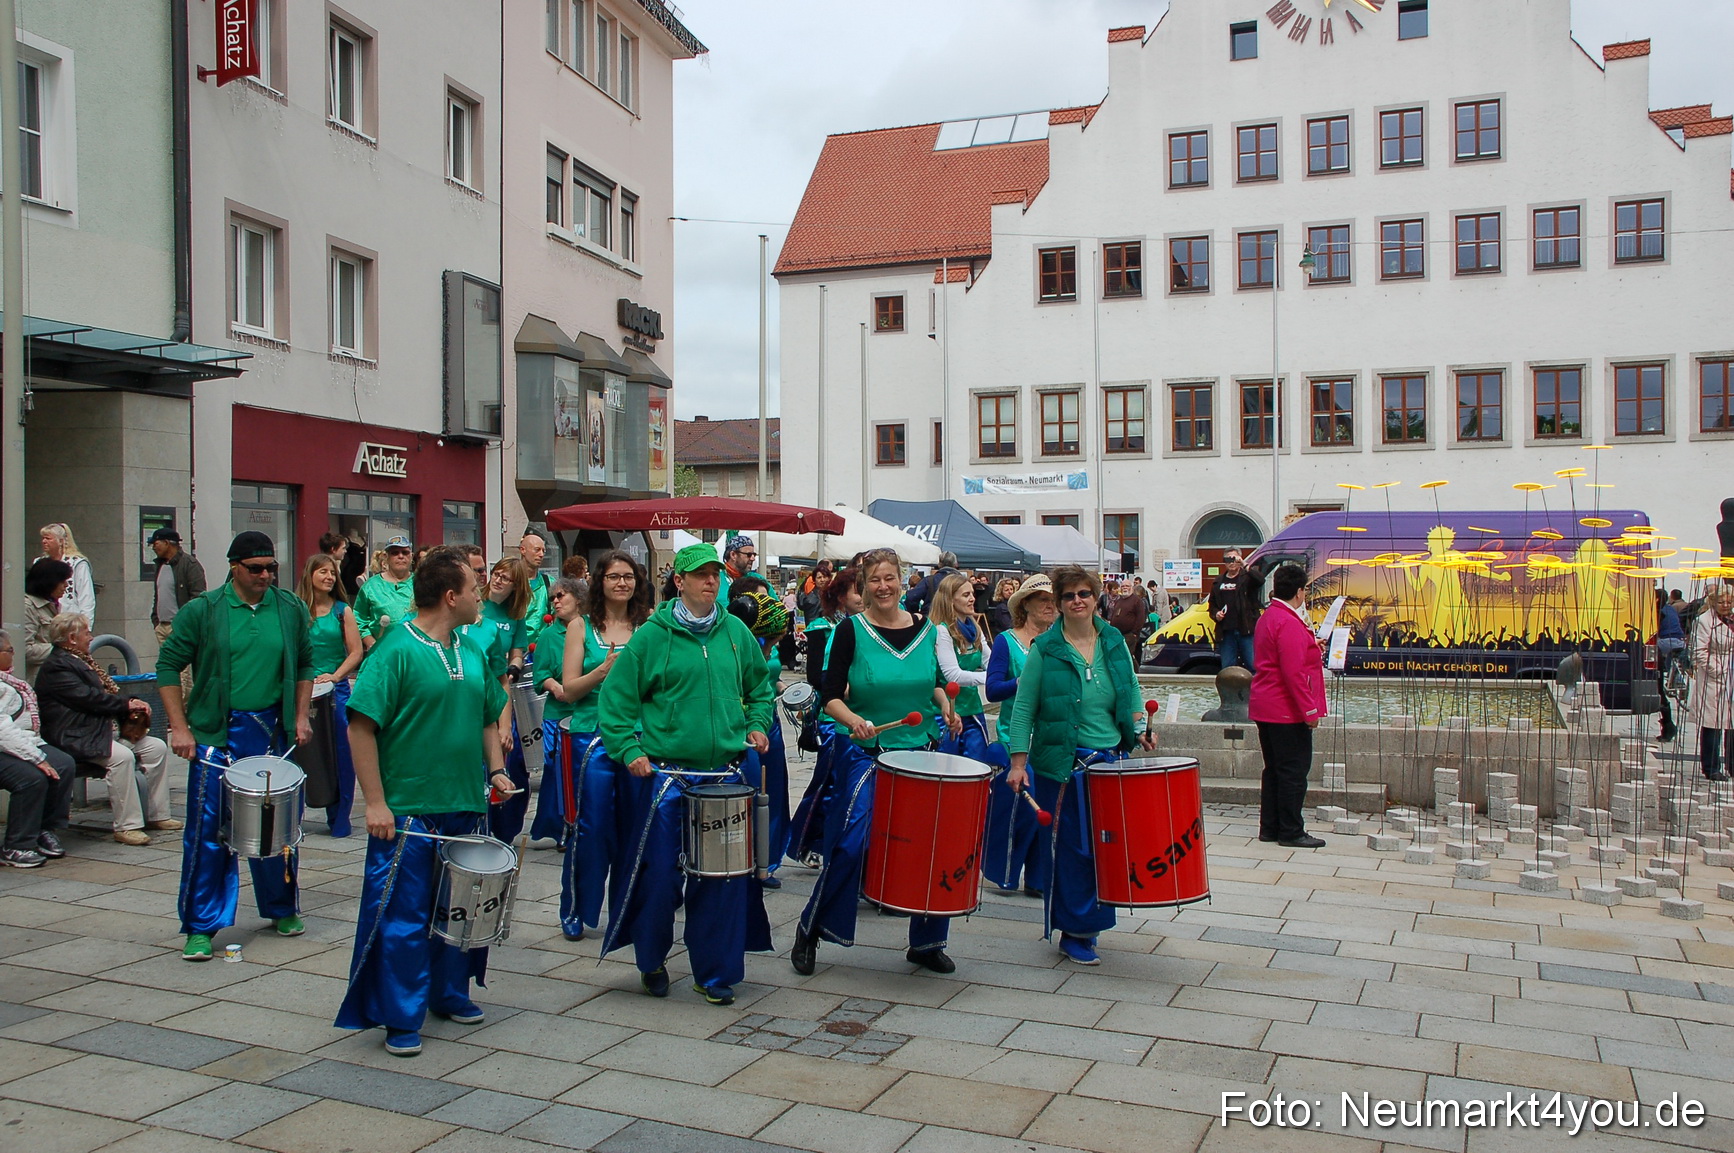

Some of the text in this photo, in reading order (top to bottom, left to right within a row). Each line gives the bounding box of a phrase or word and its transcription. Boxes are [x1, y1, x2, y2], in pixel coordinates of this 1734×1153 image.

[352, 441, 407, 475] Achatz
[1029, 474, 1064, 485] Neumarkt
[649, 511, 690, 526] Achatz
[894, 524, 940, 541] CKL
[1363, 661, 1386, 670] UND
[1406, 661, 1441, 671] NACHT
[1486, 662, 1508, 674] DIR!
